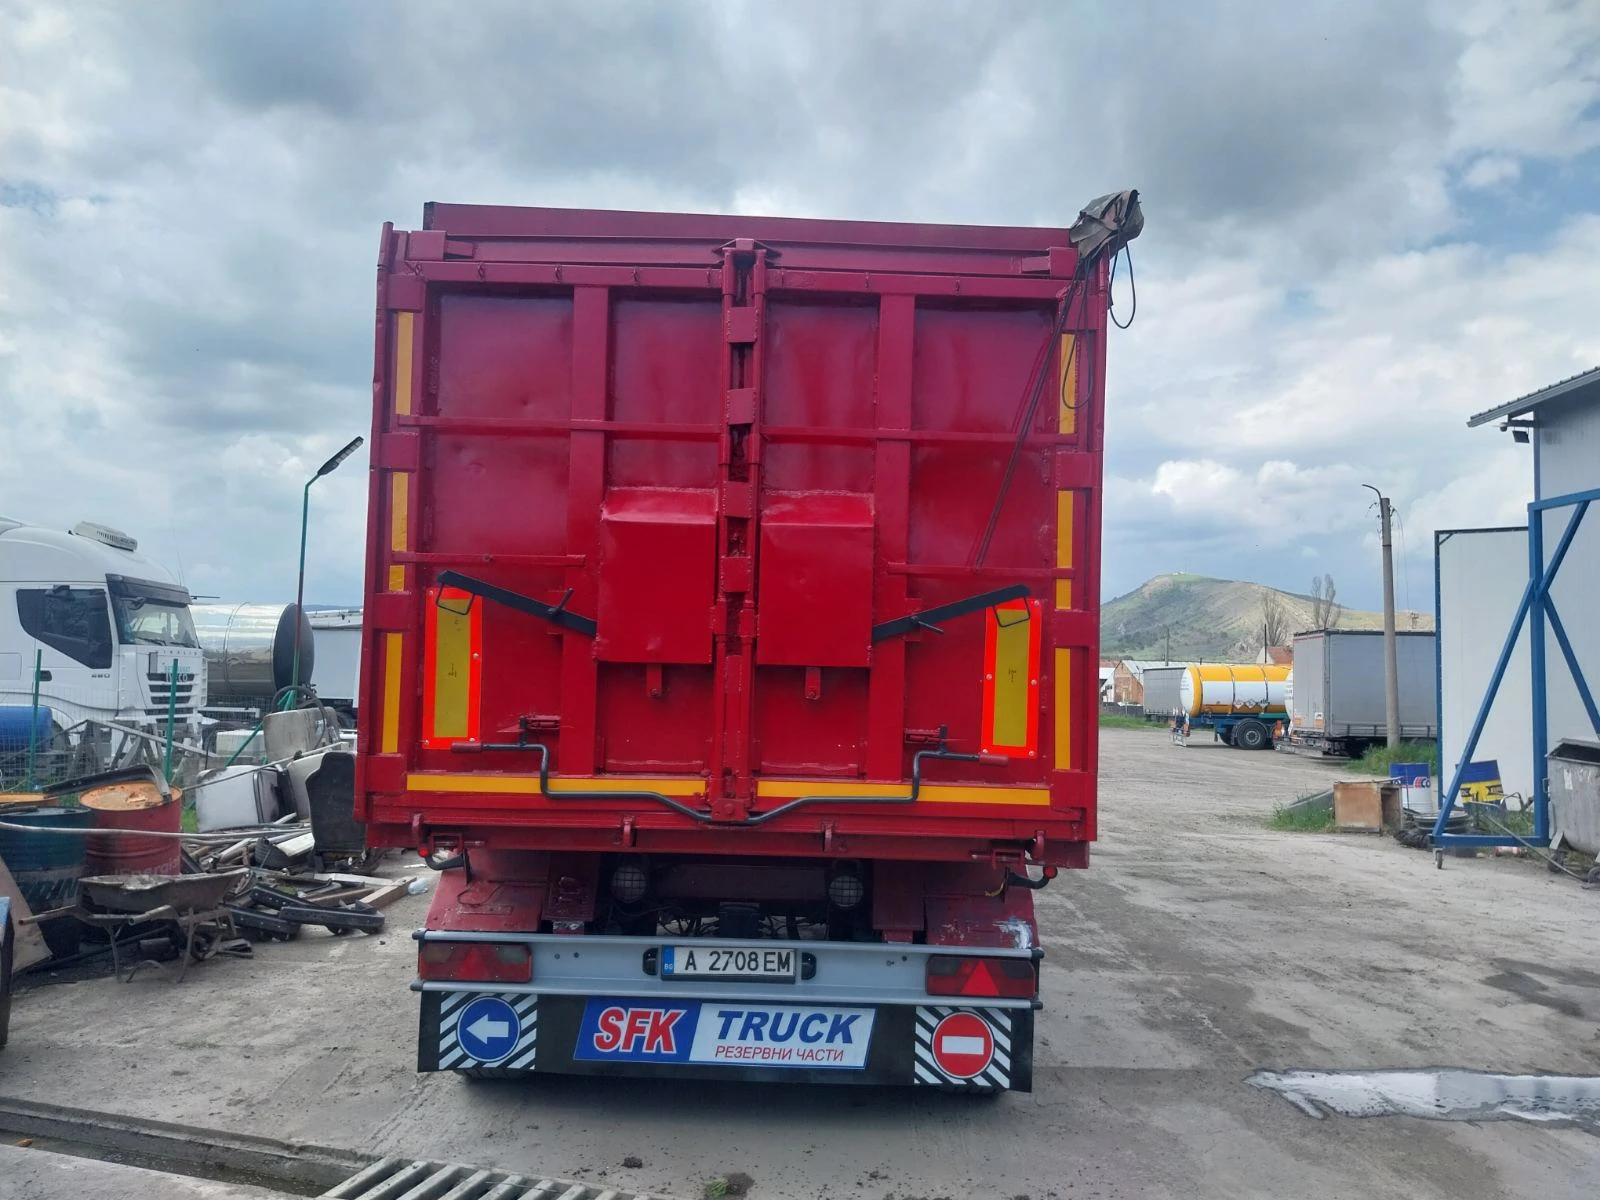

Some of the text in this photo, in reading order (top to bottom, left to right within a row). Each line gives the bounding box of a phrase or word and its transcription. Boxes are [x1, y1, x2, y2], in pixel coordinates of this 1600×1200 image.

[165, 672, 188, 682] IVCO
[684, 950, 697, 971] A
[594, 1007, 863, 1053] SFK TRUCK
[715, 1045, 845, 1062] РЕЗЕРВНИ ЧАСТИ
